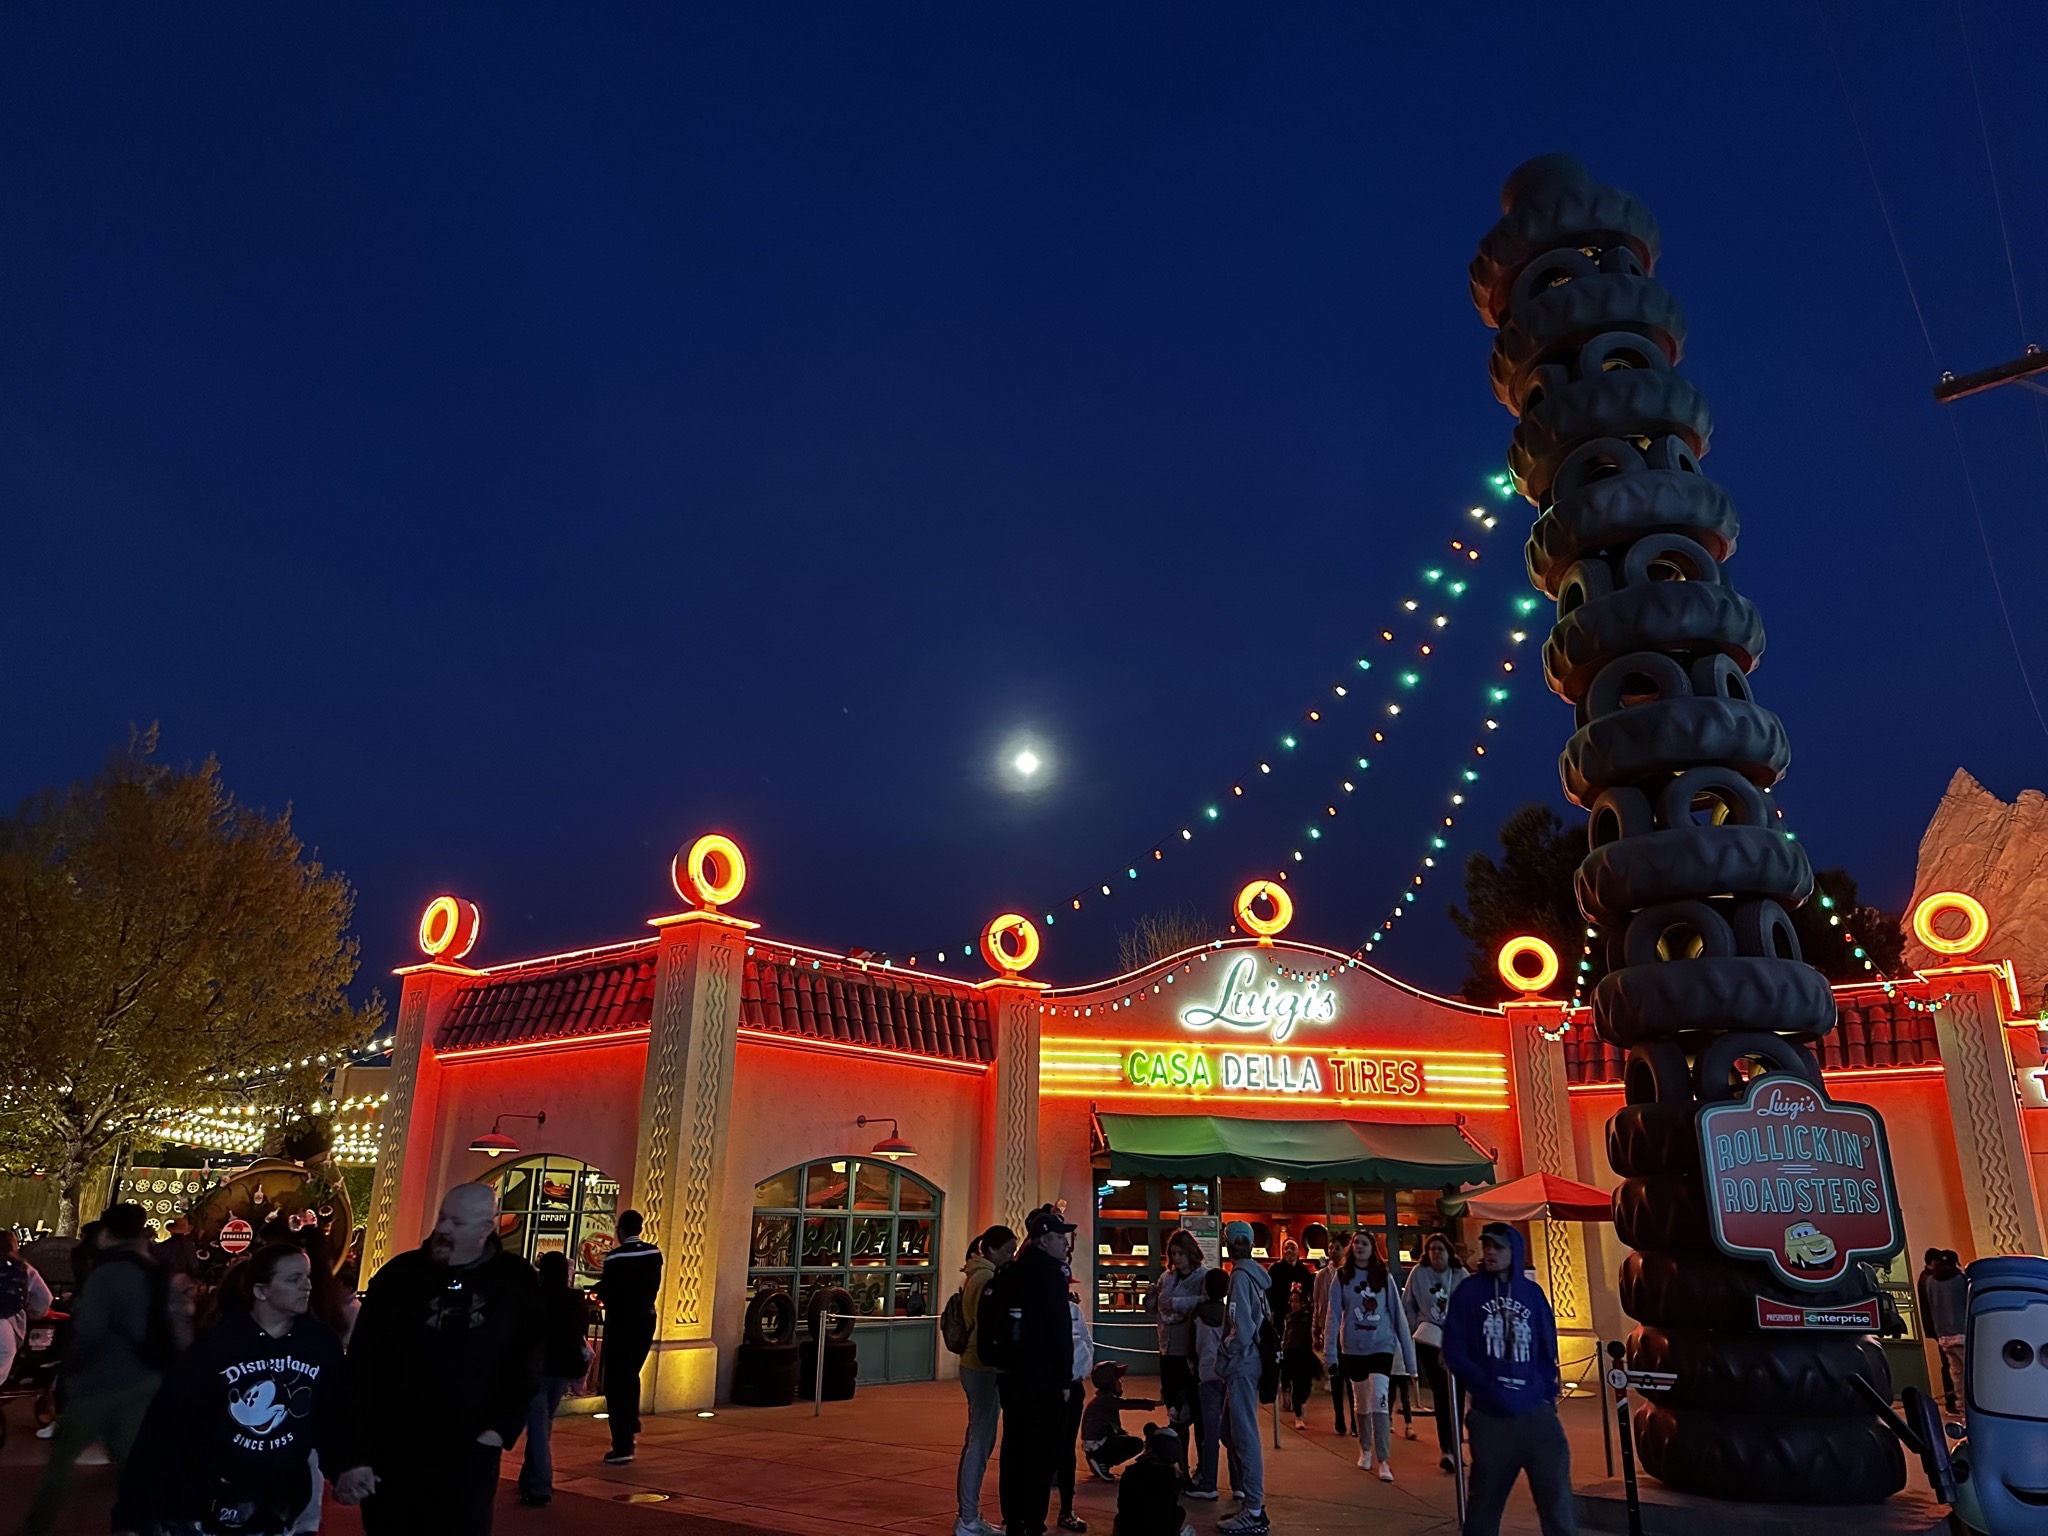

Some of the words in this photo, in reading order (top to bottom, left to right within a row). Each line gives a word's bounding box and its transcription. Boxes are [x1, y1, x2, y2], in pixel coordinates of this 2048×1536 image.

[1127, 1050, 1212, 1086] CASA
[1222, 1053, 1322, 1092] DELLA
[1328, 1058, 1421, 1095] TIRES
[1756, 1088, 1816, 1120] Luigi's
[1715, 1124, 1871, 1172] ROLLICKIN'
[1721, 1177, 1881, 1214] ROADSTERS
[1804, 1313, 1870, 1324] enterprise
[218, 1355, 320, 1385] Disneyland
[233, 1433, 265, 1451] SINCE
[269, 1432, 294, 1450] 1955
